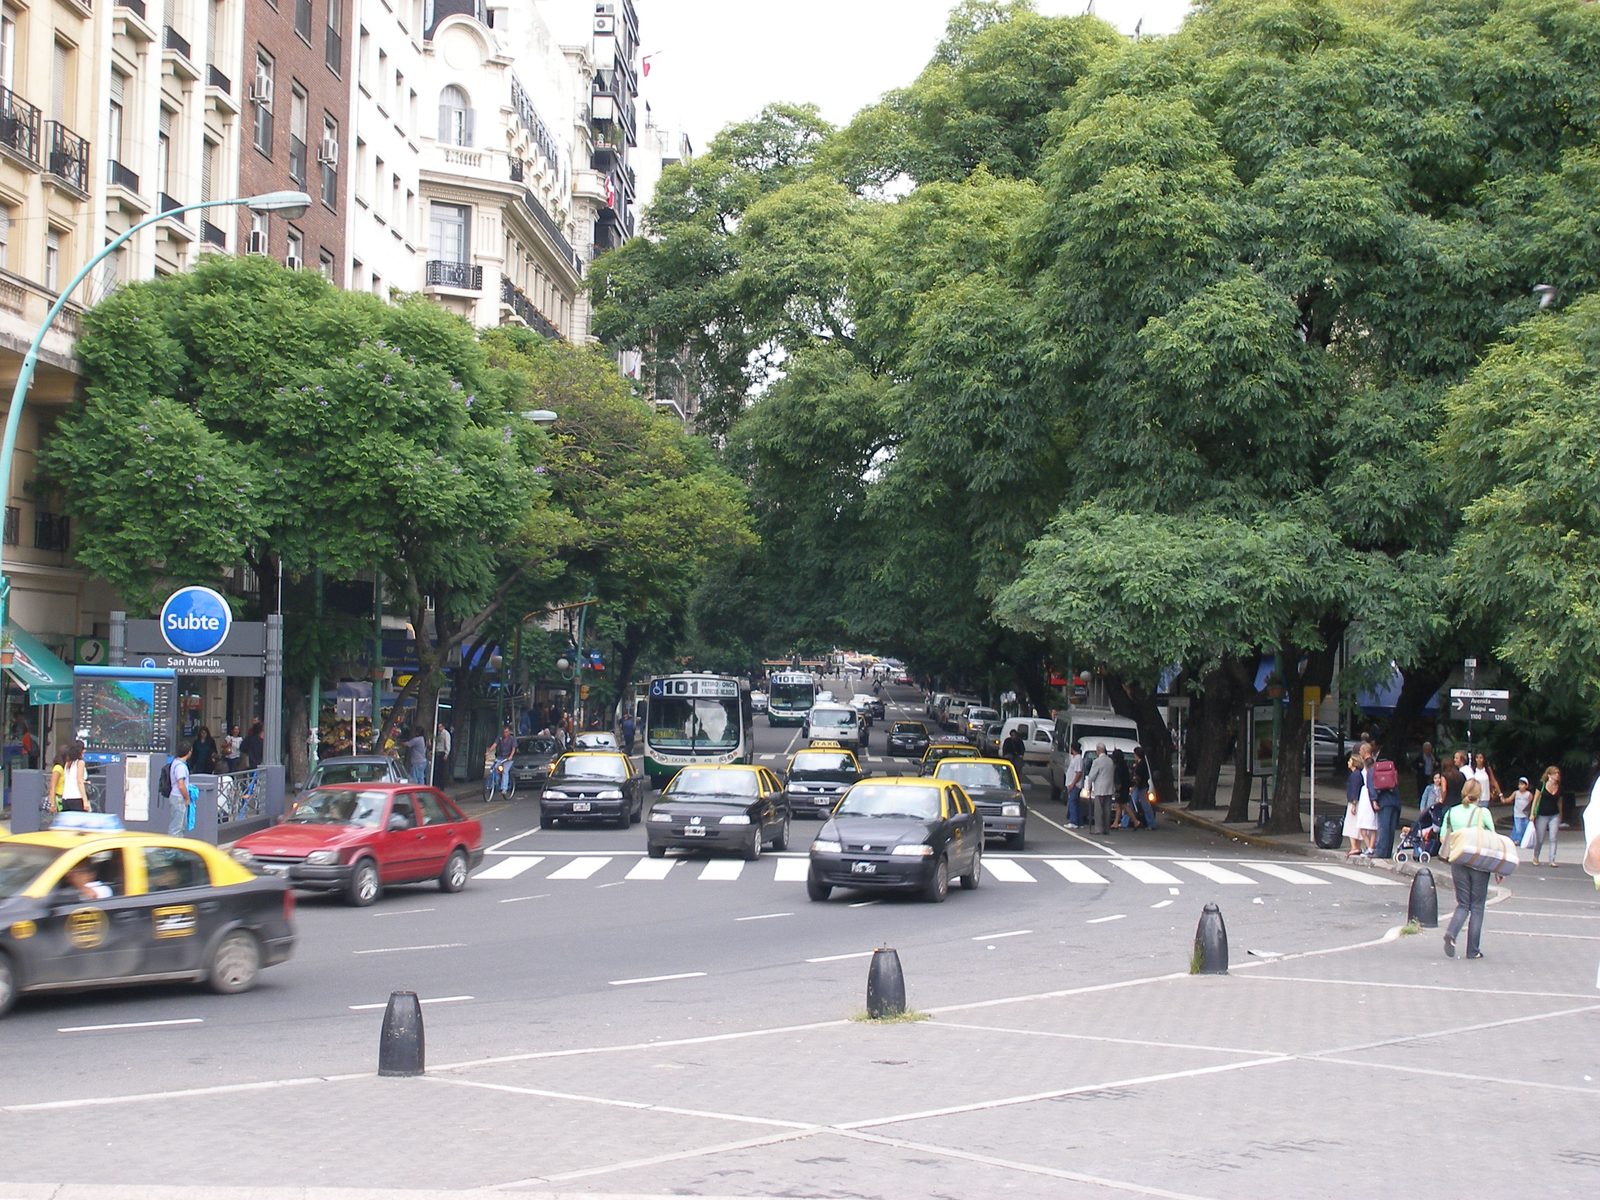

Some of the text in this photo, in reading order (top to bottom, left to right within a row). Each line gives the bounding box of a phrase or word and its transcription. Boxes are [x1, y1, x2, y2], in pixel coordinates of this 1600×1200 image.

[167, 613, 220, 630] Subte
[167, 657, 220, 667] San Martín
[665, 681, 698, 695] 101
